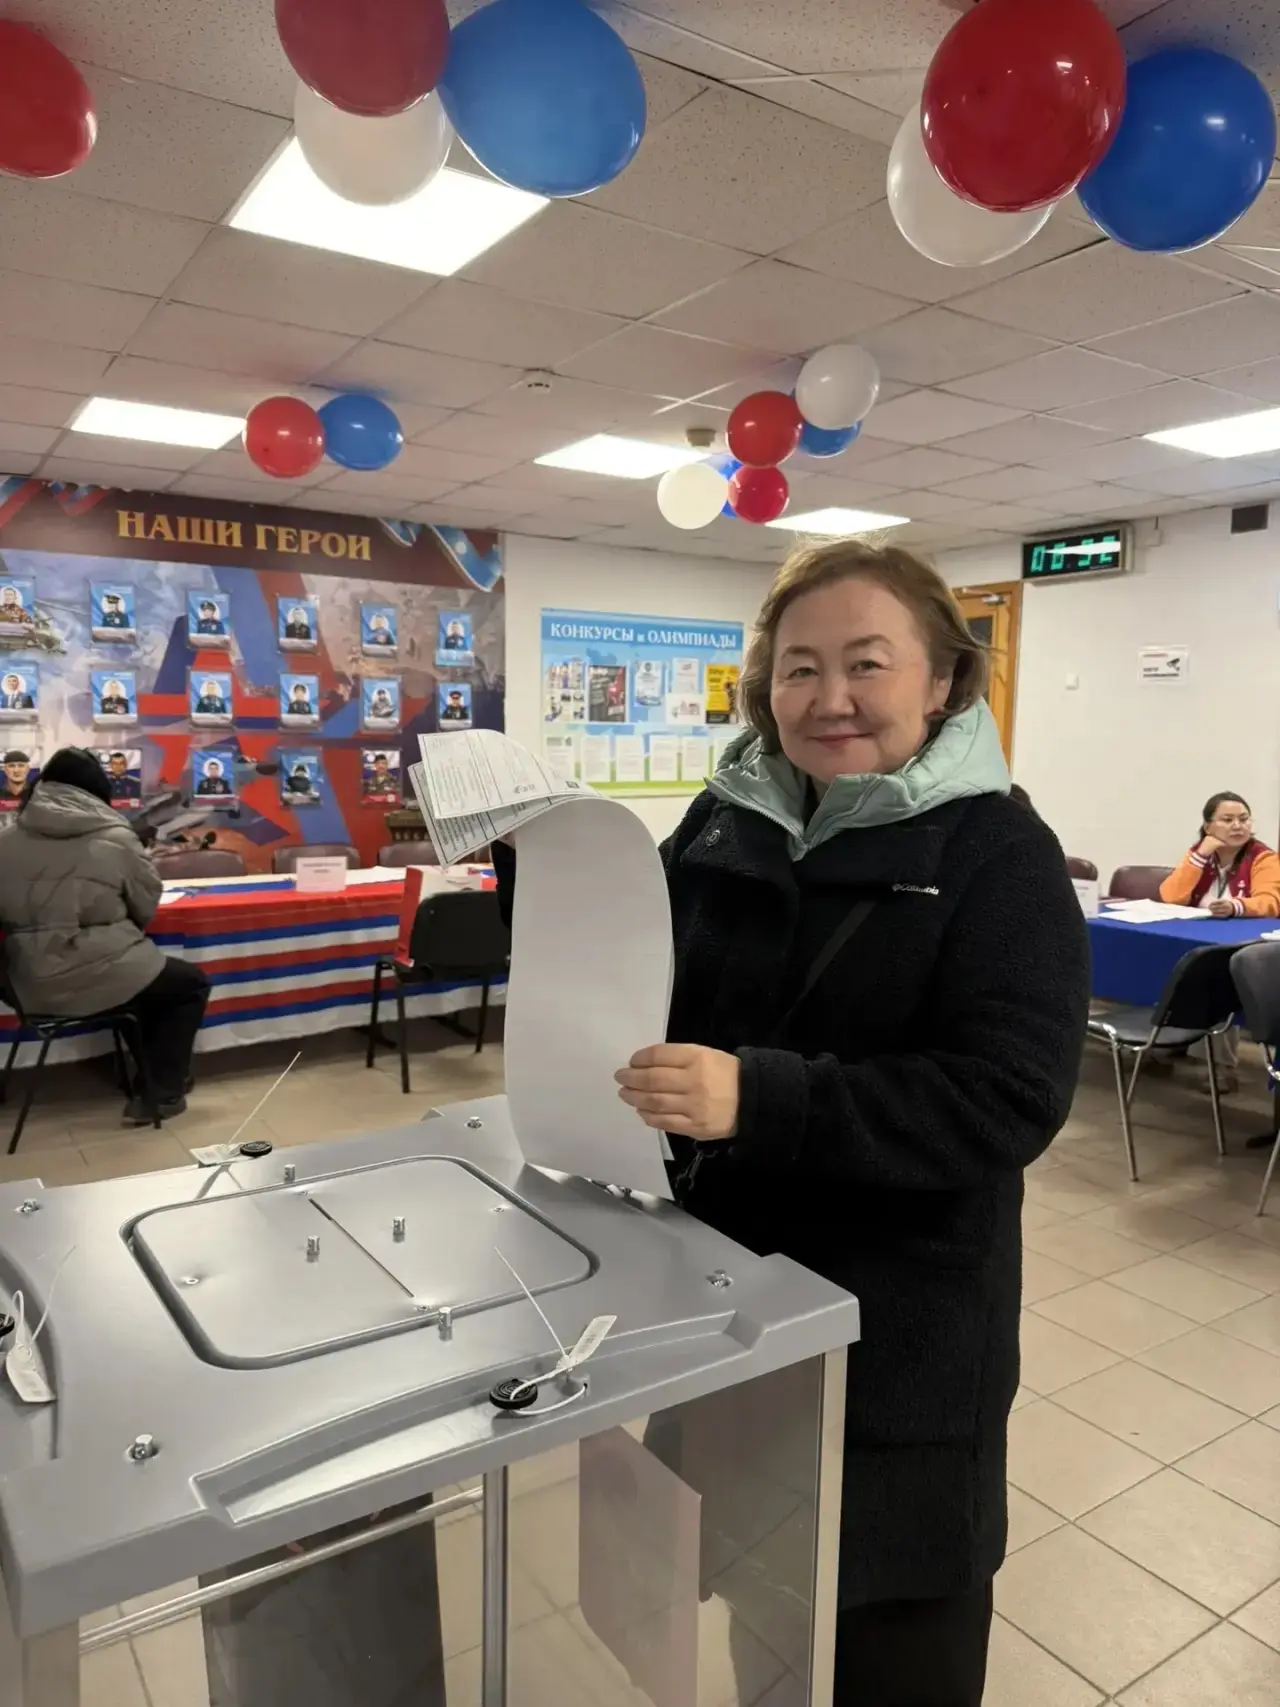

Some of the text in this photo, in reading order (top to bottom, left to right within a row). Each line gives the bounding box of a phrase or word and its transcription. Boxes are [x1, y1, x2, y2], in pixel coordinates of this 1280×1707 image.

[116, 510, 372, 561] НАШИ ГЕРОИ
[550, 622, 634, 642] КОНКУРСЫ
[648, 630, 737, 649] ОЛИМПИАДЫ
